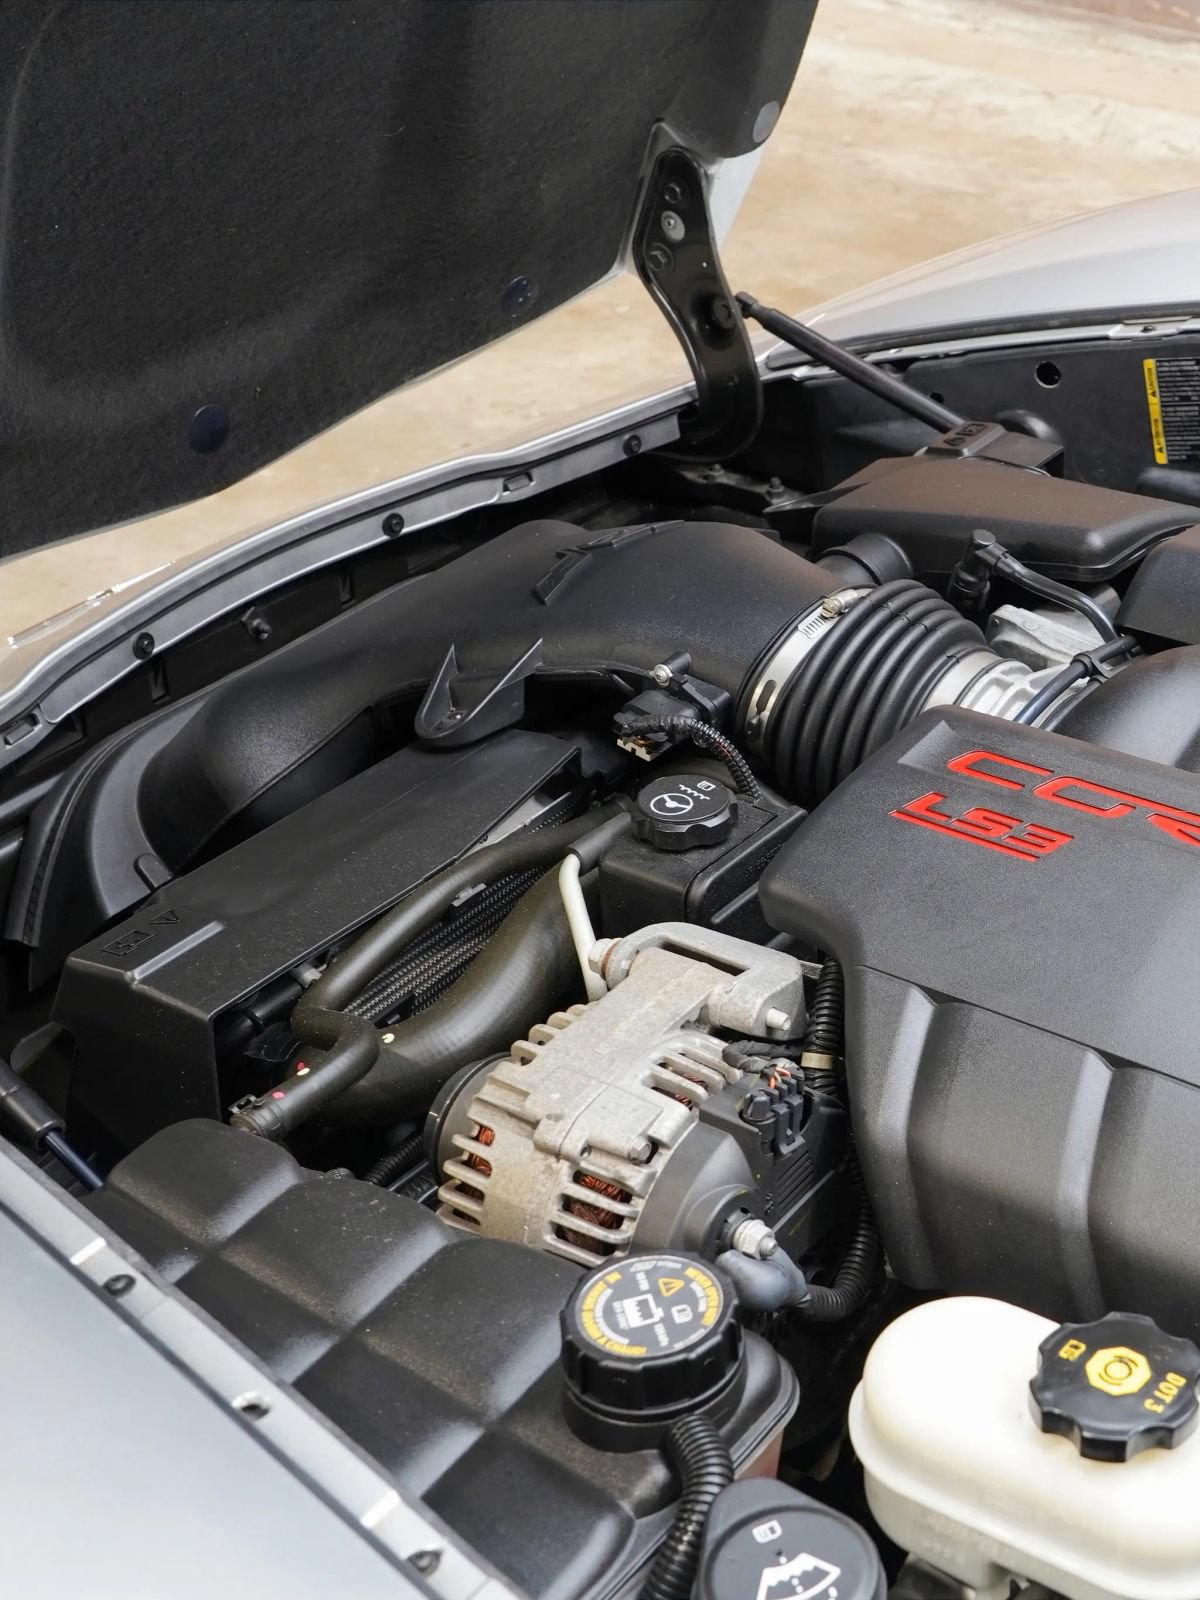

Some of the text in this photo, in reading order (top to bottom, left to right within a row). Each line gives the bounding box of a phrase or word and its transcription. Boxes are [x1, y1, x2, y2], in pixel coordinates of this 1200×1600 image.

[890, 792, 1073, 862] LS3
[1144, 1372, 1187, 1413] DOT 3
